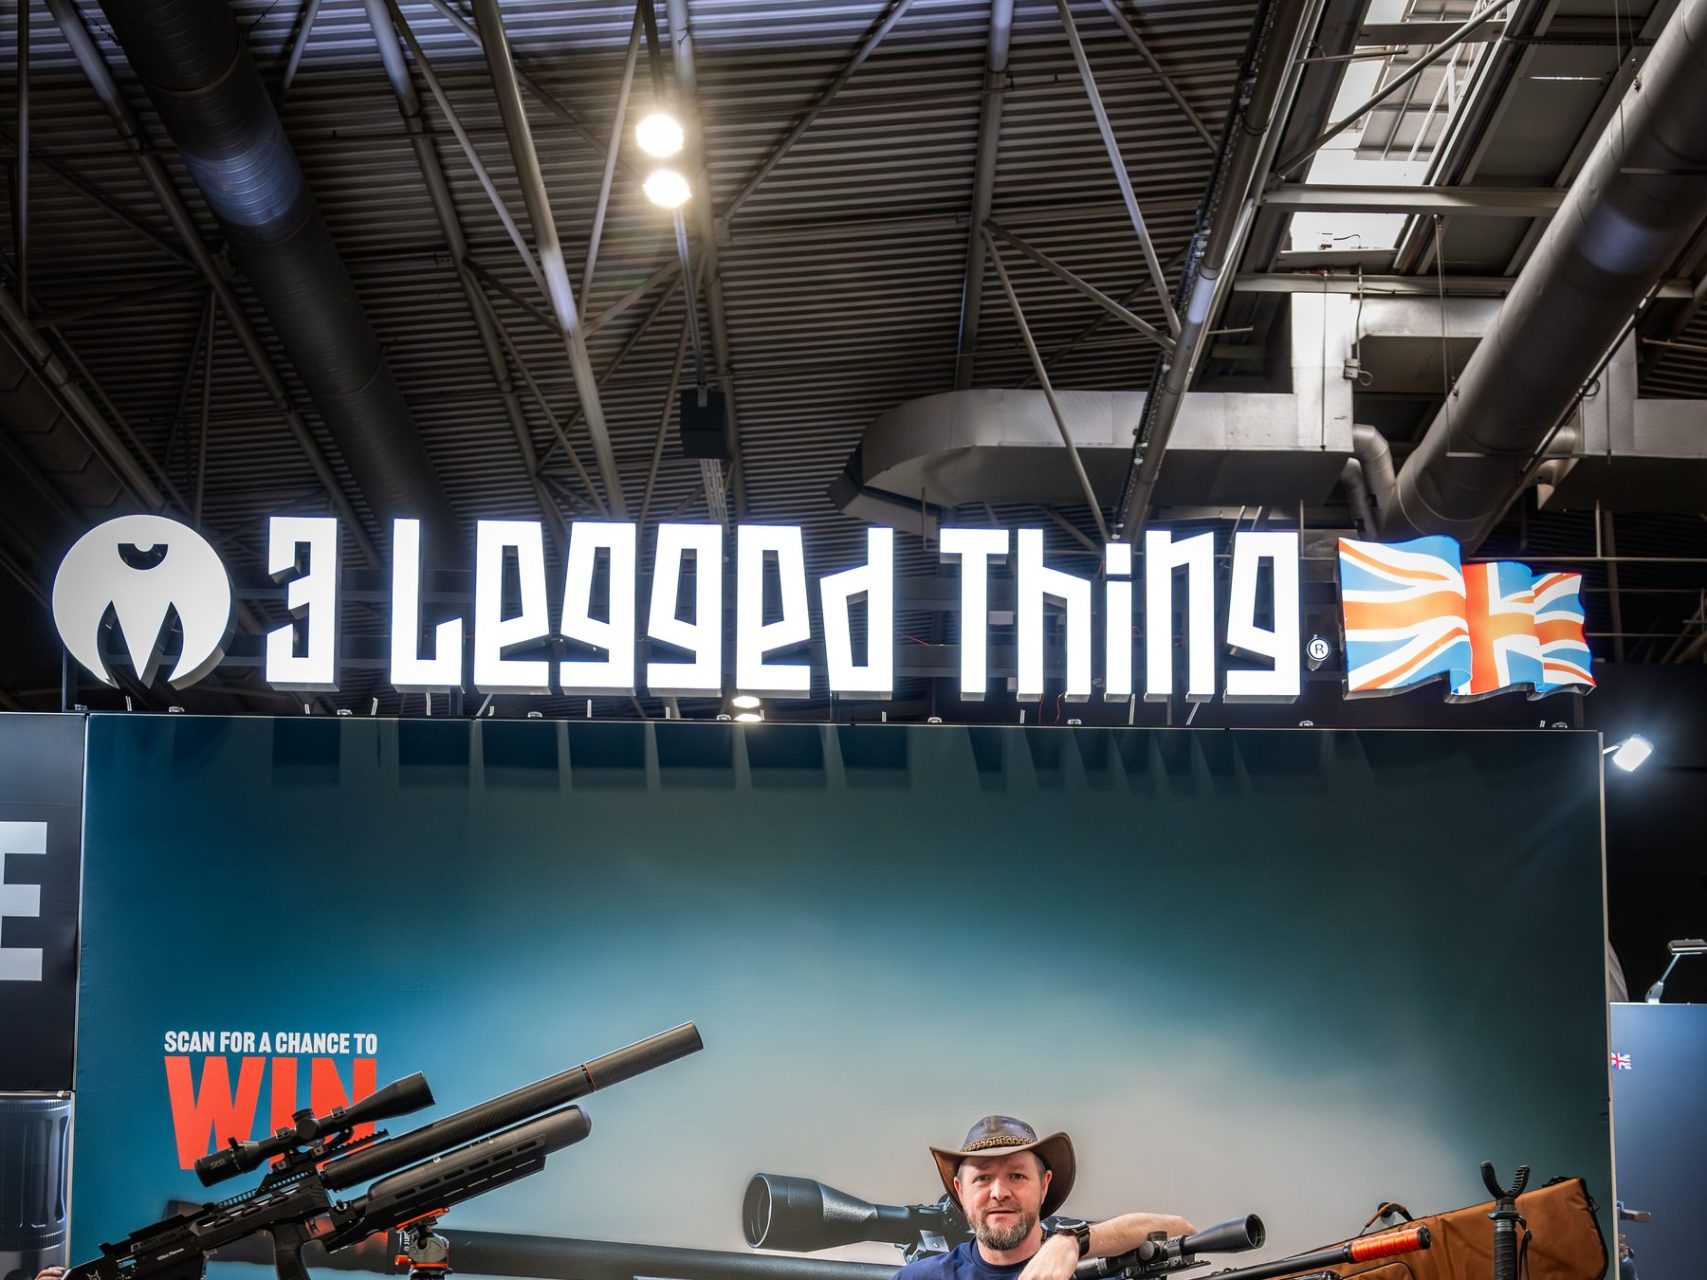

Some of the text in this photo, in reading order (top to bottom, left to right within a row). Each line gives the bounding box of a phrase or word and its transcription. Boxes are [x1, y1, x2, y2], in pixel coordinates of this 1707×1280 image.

[266, 516, 337, 684] 3
[390, 518, 894, 692] Legged
[164, 1031, 378, 1055] SCAN FOR A CHANCE TO
[164, 1055, 377, 1170] WIN
